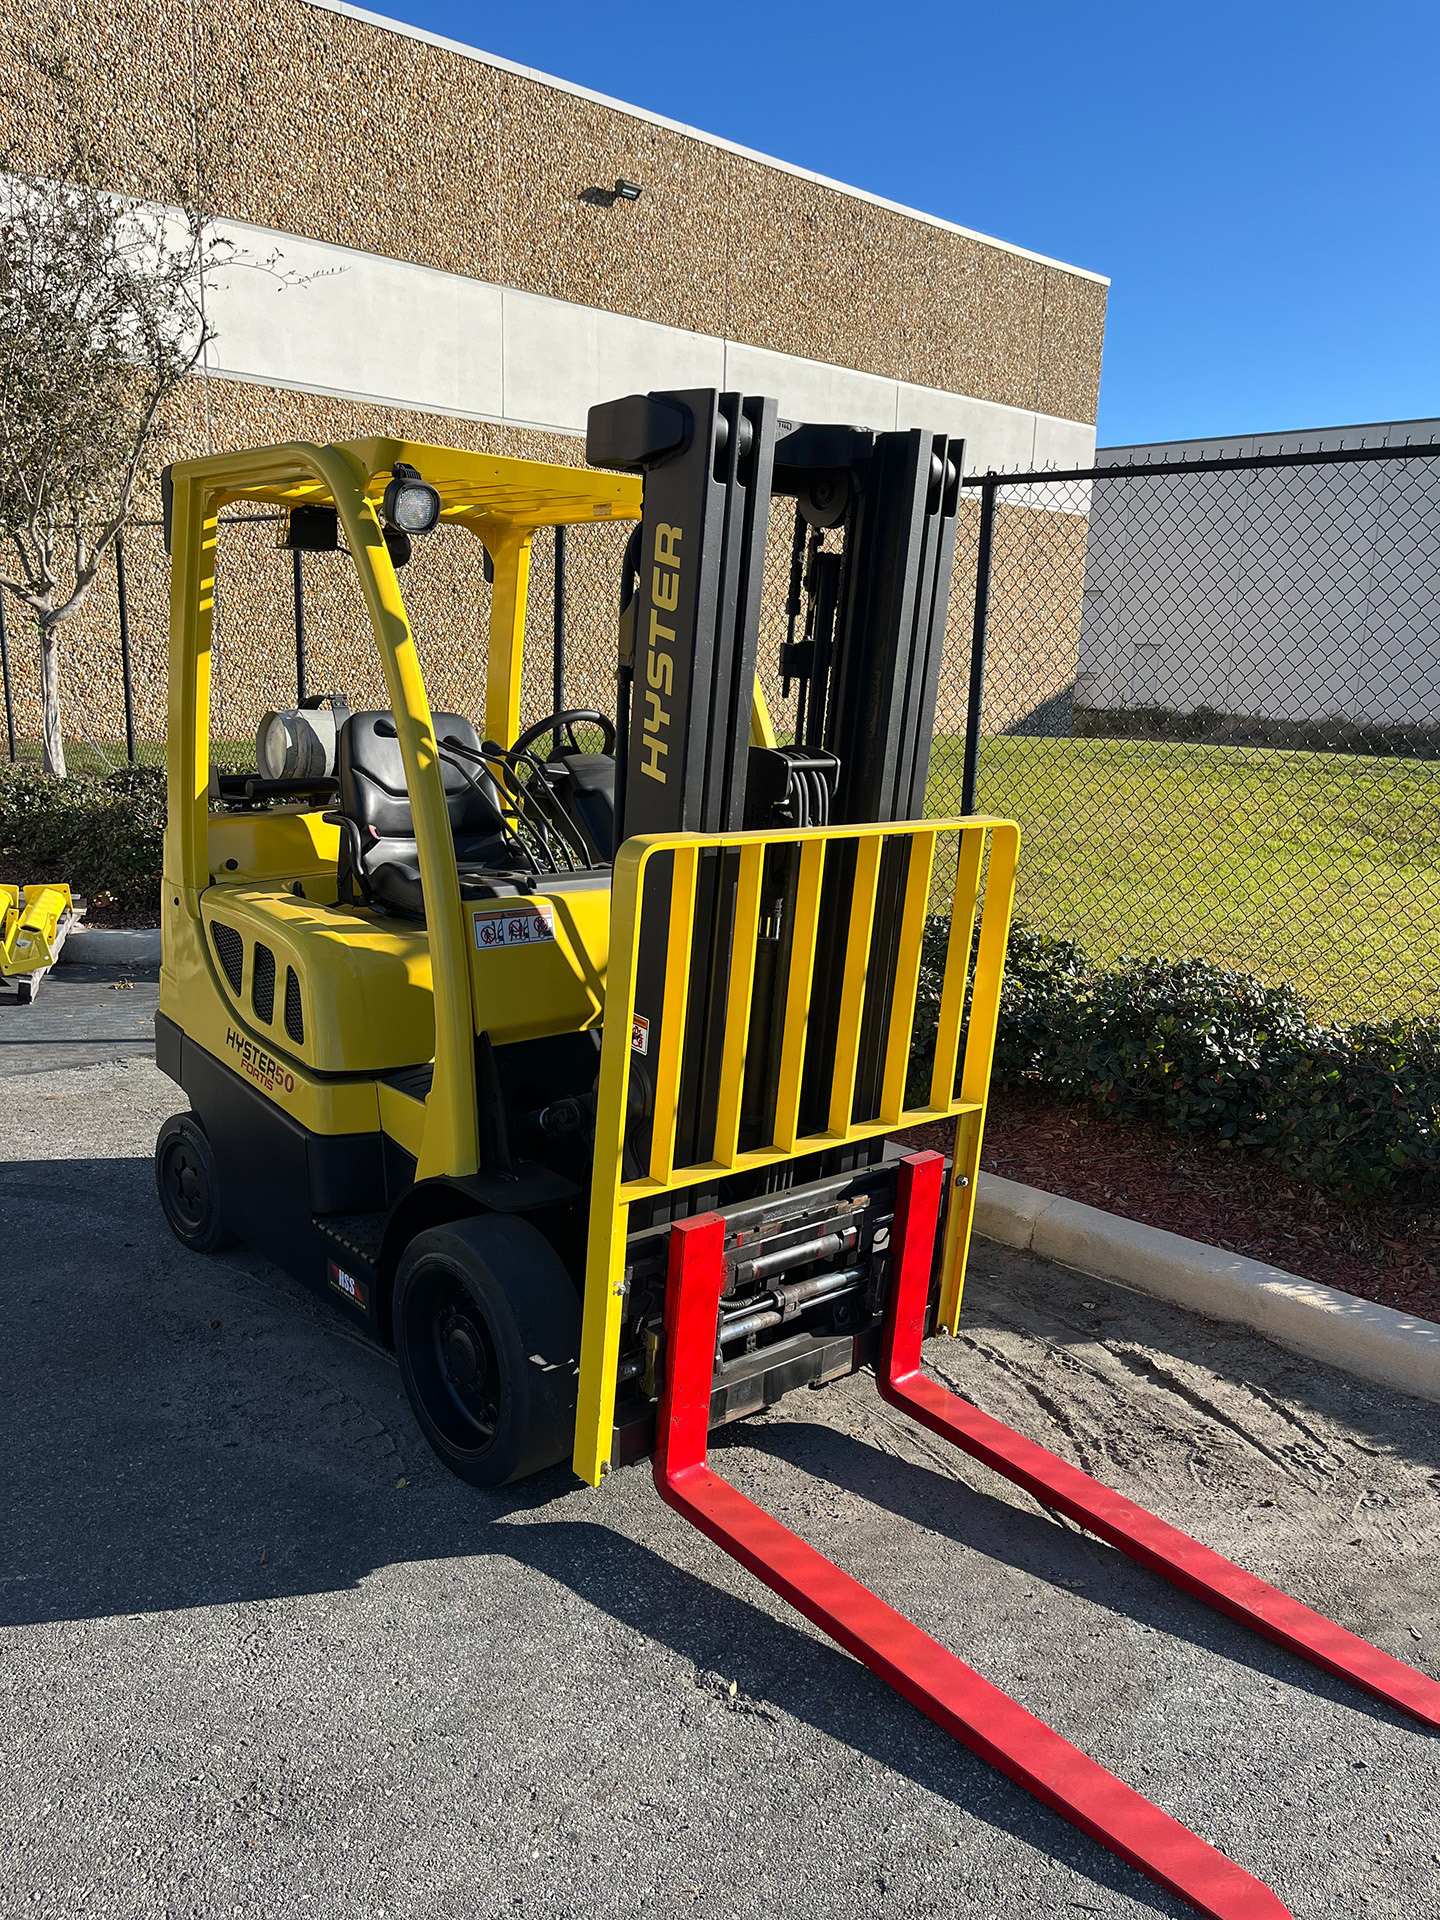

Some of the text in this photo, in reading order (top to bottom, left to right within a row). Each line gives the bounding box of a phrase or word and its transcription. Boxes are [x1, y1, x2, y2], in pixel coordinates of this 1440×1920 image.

[640, 522, 683, 784] HYSTER
[240, 1058, 274, 1091] FORTIS
[338, 1269, 355, 1295] HSS
